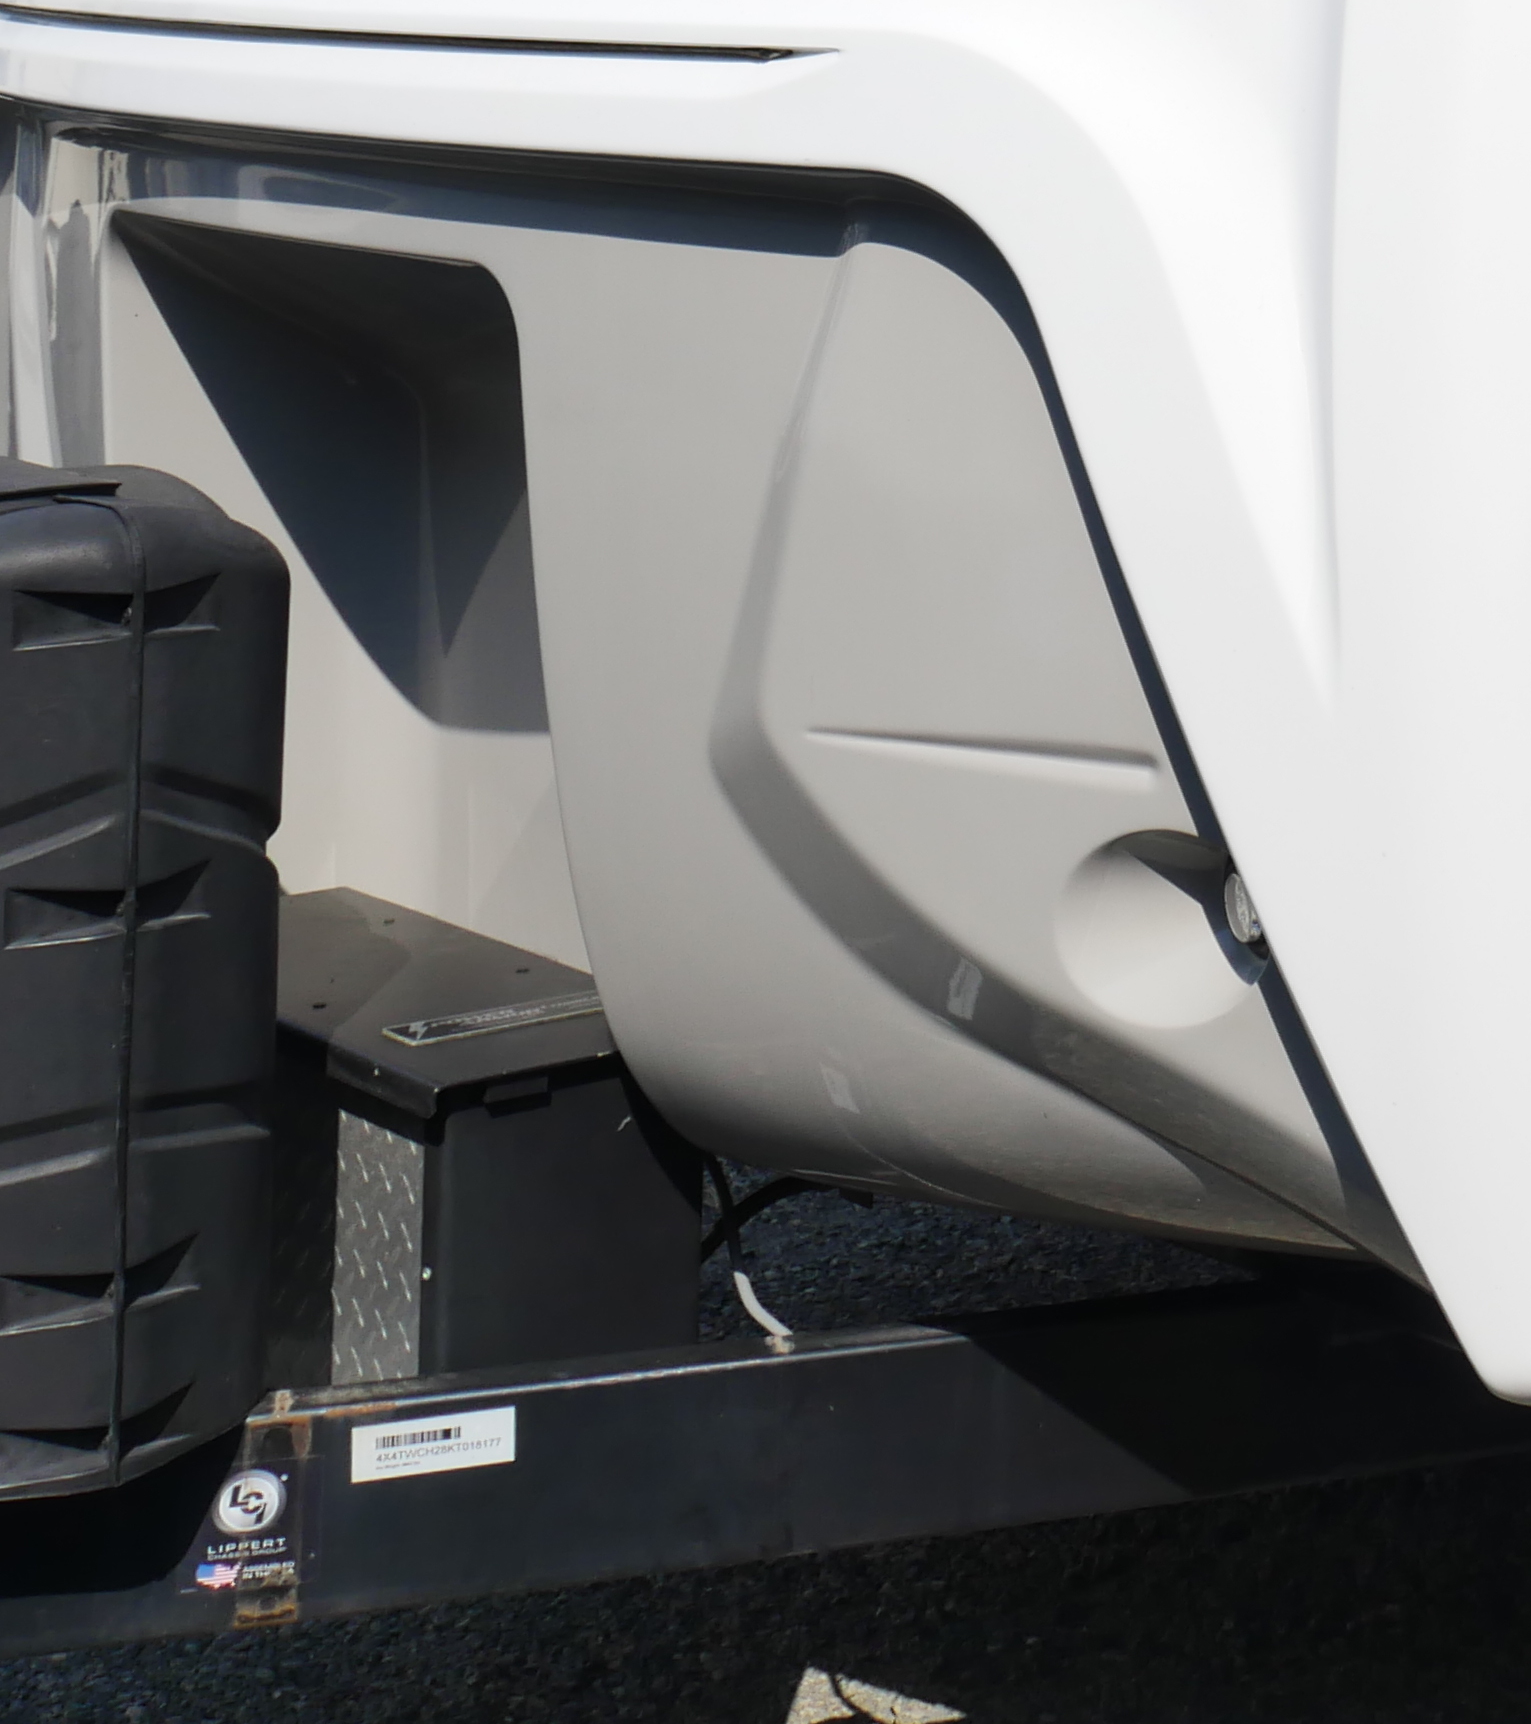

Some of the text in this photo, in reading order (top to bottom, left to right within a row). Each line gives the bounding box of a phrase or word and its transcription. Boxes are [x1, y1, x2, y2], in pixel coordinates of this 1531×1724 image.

[376, 1437, 502, 1462] 4X4TWCH28KT018177
[229, 1484, 267, 1525] LCI
[207, 1537, 286, 1555] LIPPERT
